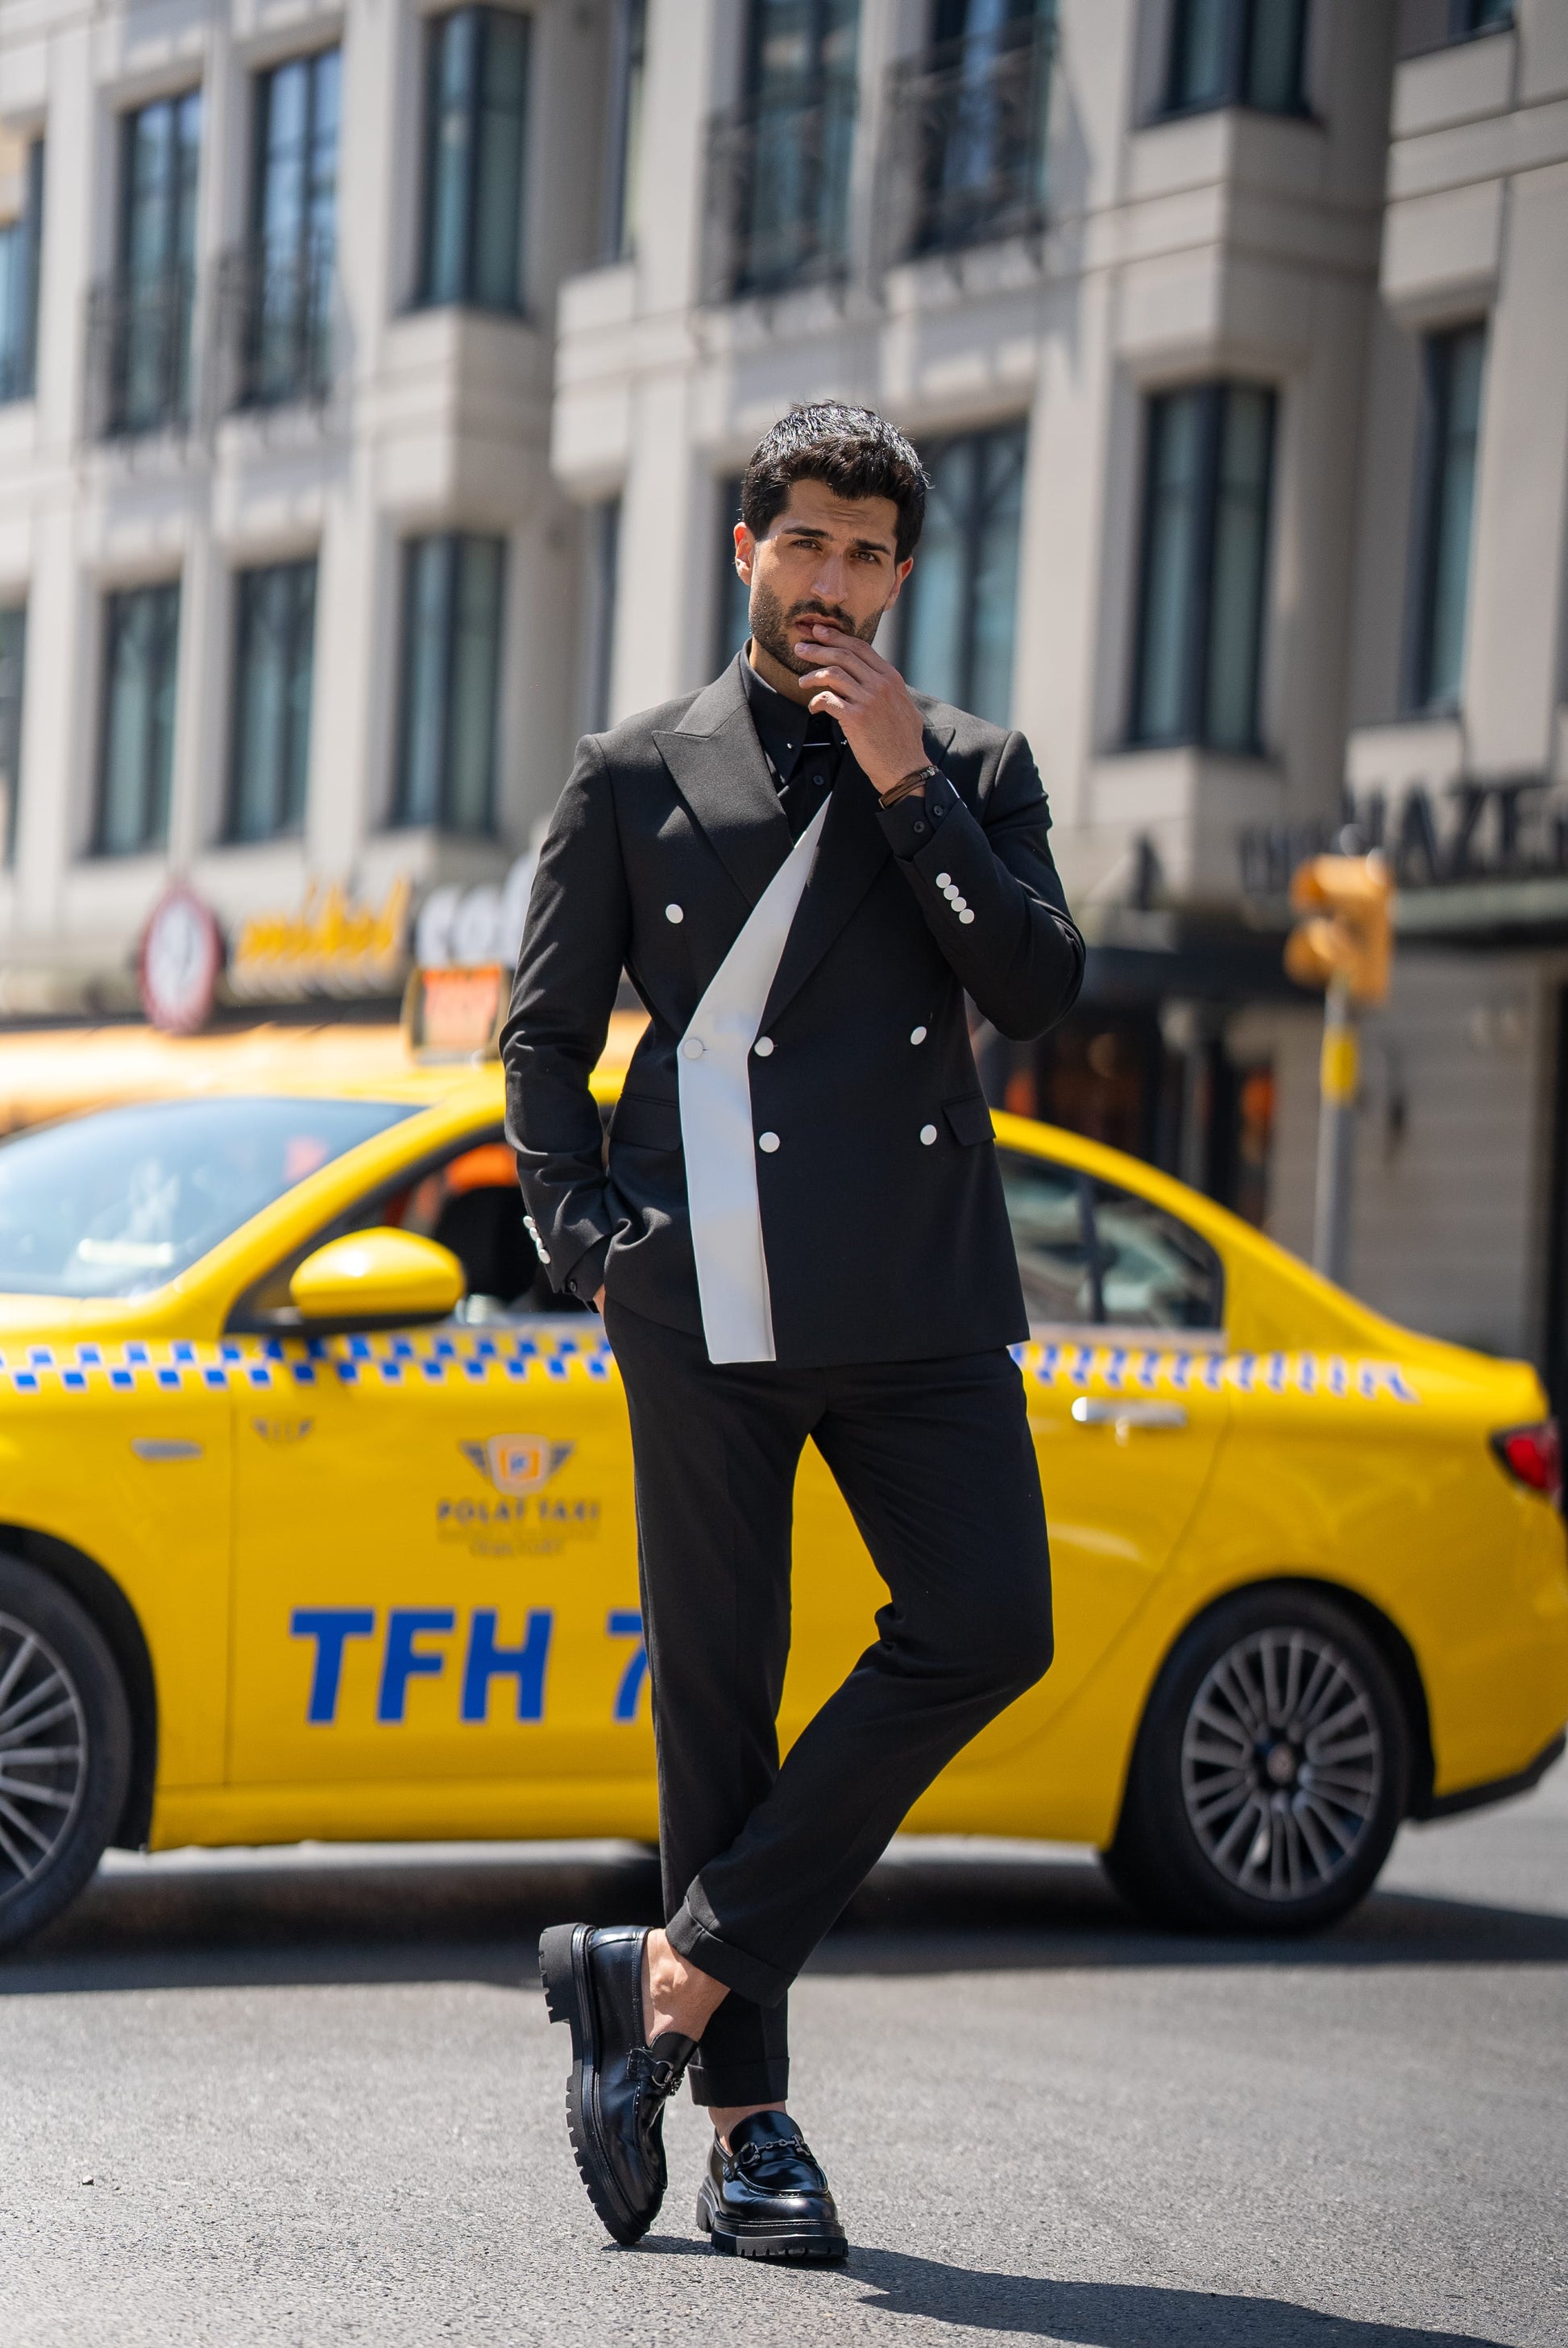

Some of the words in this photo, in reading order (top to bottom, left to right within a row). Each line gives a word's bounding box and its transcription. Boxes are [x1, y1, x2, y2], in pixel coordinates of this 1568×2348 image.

[436, 1499, 528, 1525] POLAT
[537, 1499, 600, 1523] TAXI
[289, 1608, 554, 1724] TFH
